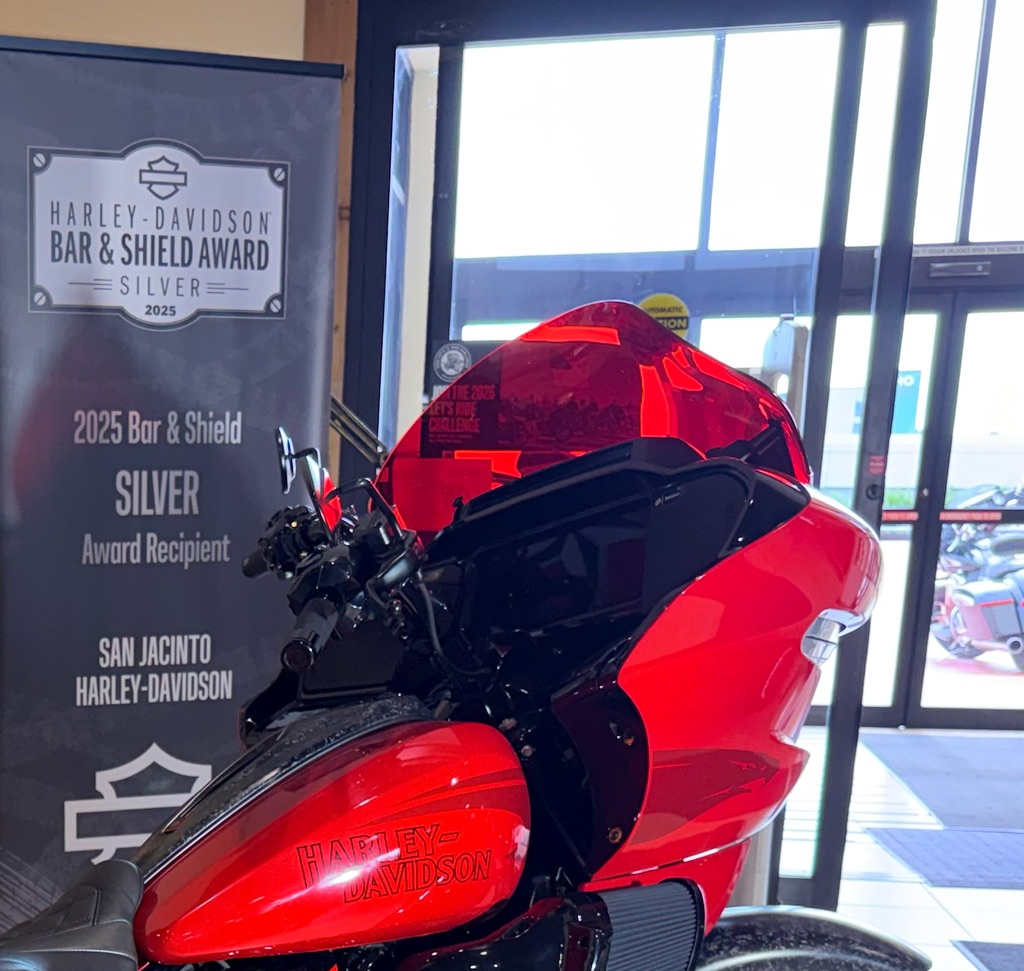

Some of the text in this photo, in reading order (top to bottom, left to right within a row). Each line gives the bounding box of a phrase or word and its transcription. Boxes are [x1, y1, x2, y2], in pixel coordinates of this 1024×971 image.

[50, 230, 270, 271] BAR & SHIELD AWARD
[119, 275, 200, 297] SILVER
[144, 304, 177, 316] 2025
[74, 409, 242, 445] 2025 Bar & Shield
[115, 470, 200, 516] SILVER
[81, 531, 231, 570] Award Recipient
[98, 633, 212, 668] SAN JACINTO
[76, 669, 233, 707] HARLEY-DAVIDSON
[343, 849, 492, 904] DAVIDSON
